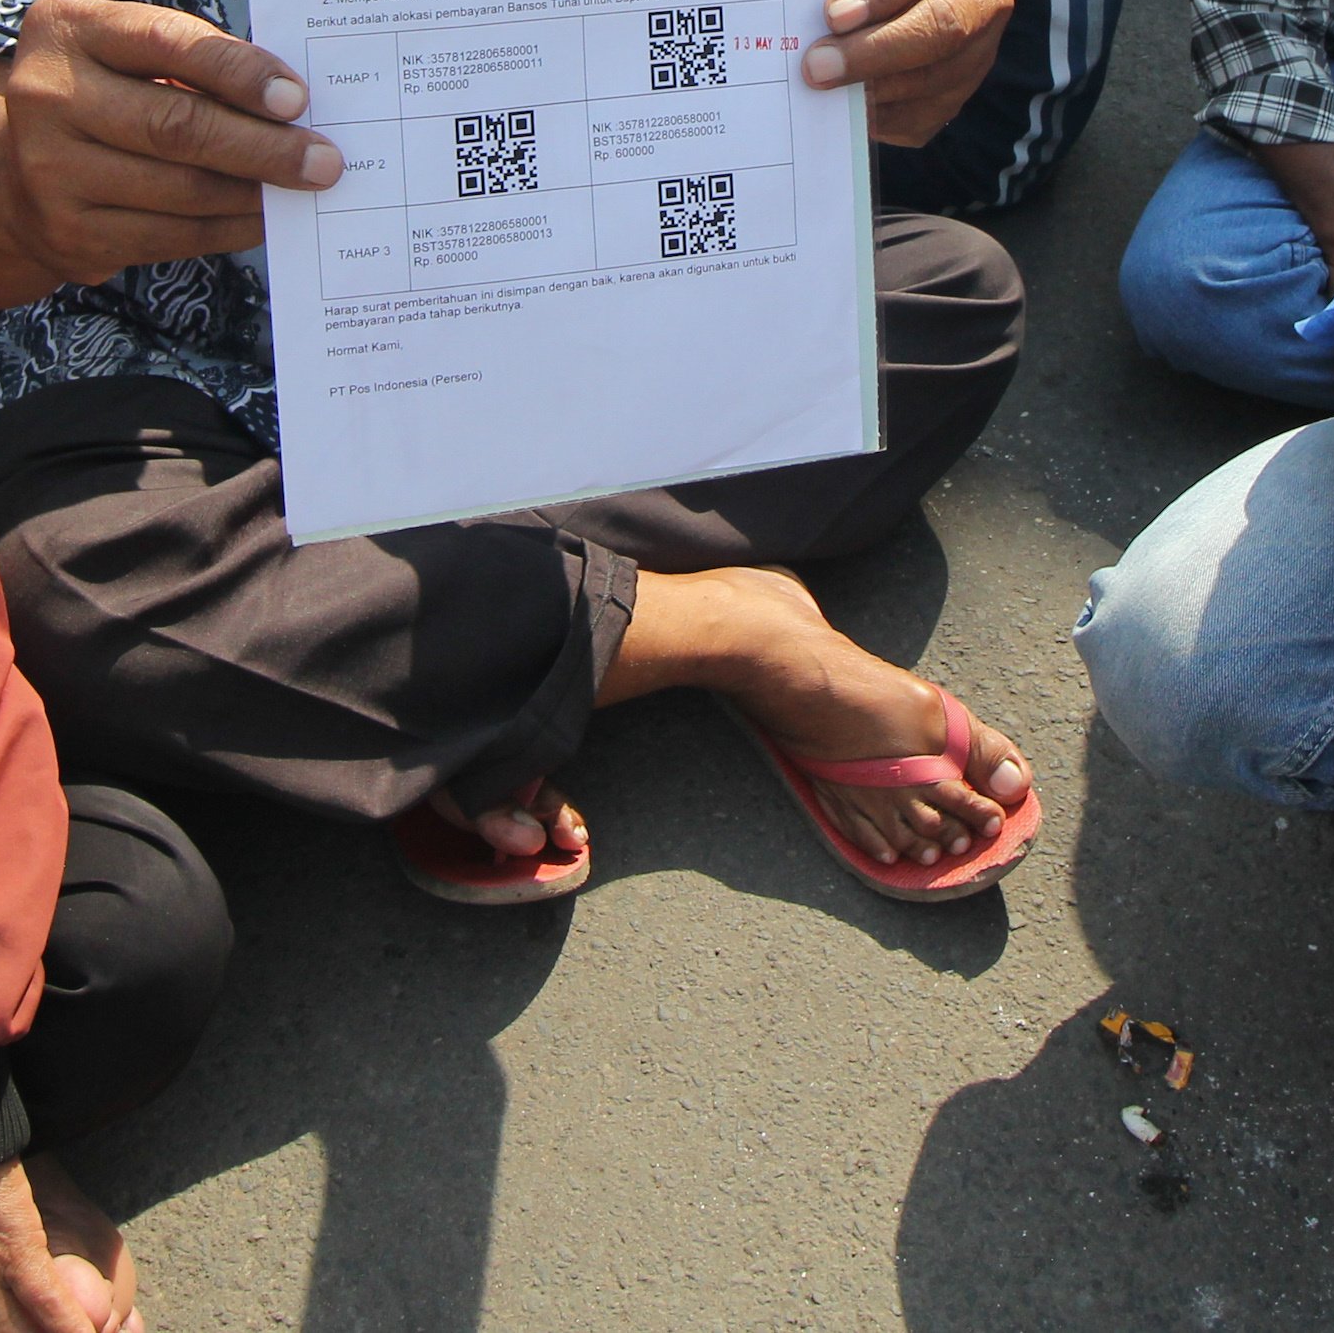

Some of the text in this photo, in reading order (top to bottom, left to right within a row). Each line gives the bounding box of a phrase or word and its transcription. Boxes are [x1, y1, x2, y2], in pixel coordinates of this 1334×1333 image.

[307, 16, 348, 29] Berikut
[351, 13, 389, 26] adalah
[393, 10, 433, 23] alokasi
[436, 6, 505, 21] pembayaran
[508, 2, 548, 13] Bansos
[756, 37, 773, 50] MAY
[780, 36, 799, 50] 2020
[403, 55, 424, 66] NIK
[330, 73, 370, 86] TAHAP
[404, 78, 470, 96] Rp. 600000
[593, 122, 612, 134] NIK
[594, 145, 655, 162] Rp. 600000
[343, 159, 386, 172] AHAP 2
[413, 228, 434, 240] NIK
[340, 246, 391, 260] TAHAP 3
[414, 251, 479, 269] Rp. 600000
[325, 306, 360, 317] Harap
[362, 301, 392, 314] surat
[394, 293, 478, 313] pemberitahuan
[481, 290, 495, 300] ini
[497, 286, 546, 301] disimpan
[549, 280, 589, 292] dengan
[620, 272, 656, 283] karena
[659, 268, 684, 279] akan
[687, 261, 740, 276] digunakan
[743, 256, 770, 268] untuk
[773, 253, 797, 264] bukti
[326, 301, 524, 333] pembayaran pada tahap berikutnya.
[327, 340, 403, 358] Hormat Kami,
[330, 371, 483, 398] PT Pos Indonesia (Persero)
